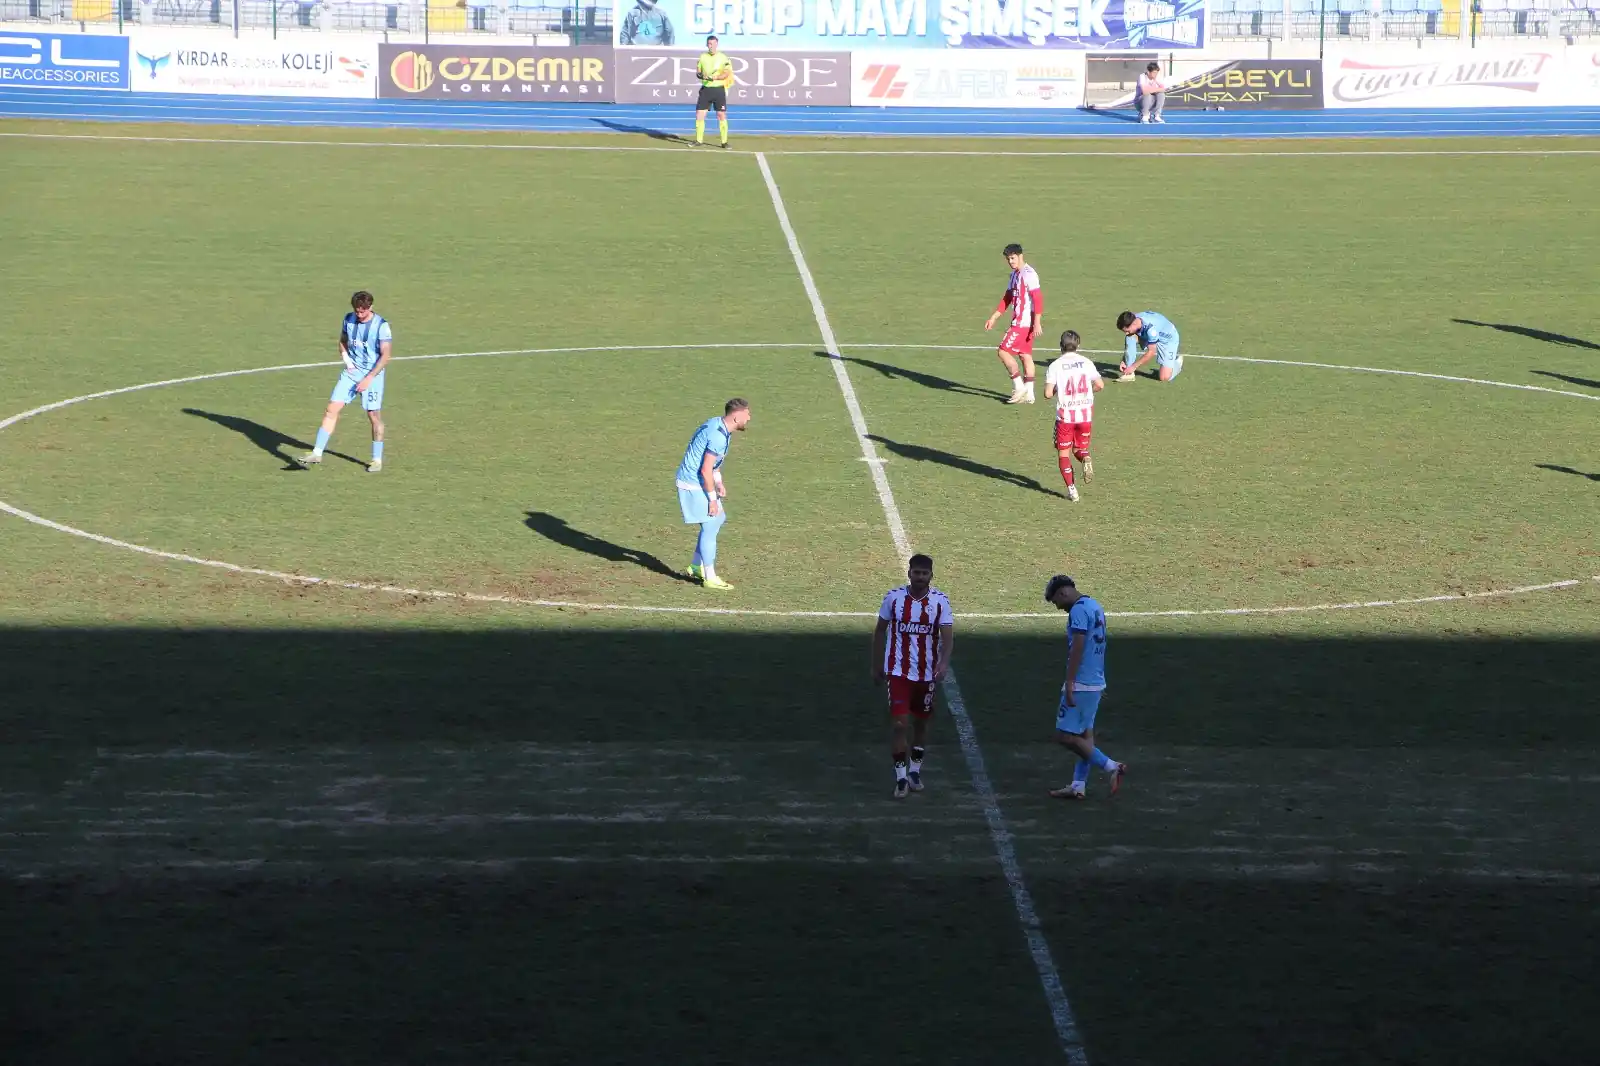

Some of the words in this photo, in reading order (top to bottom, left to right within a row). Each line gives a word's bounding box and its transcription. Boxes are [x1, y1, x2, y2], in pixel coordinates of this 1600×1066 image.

[686, 0, 804, 36] GRUP
[177, 50, 229, 68] KIRDAR
[0, 67, 120, 84] EACCESSORIES
[913, 67, 1010, 100] ZAFER
[442, 83, 603, 94] LOKANTASI
[652, 89, 813, 100] KUYCULUK
[1065, 373, 1089, 397] 44
